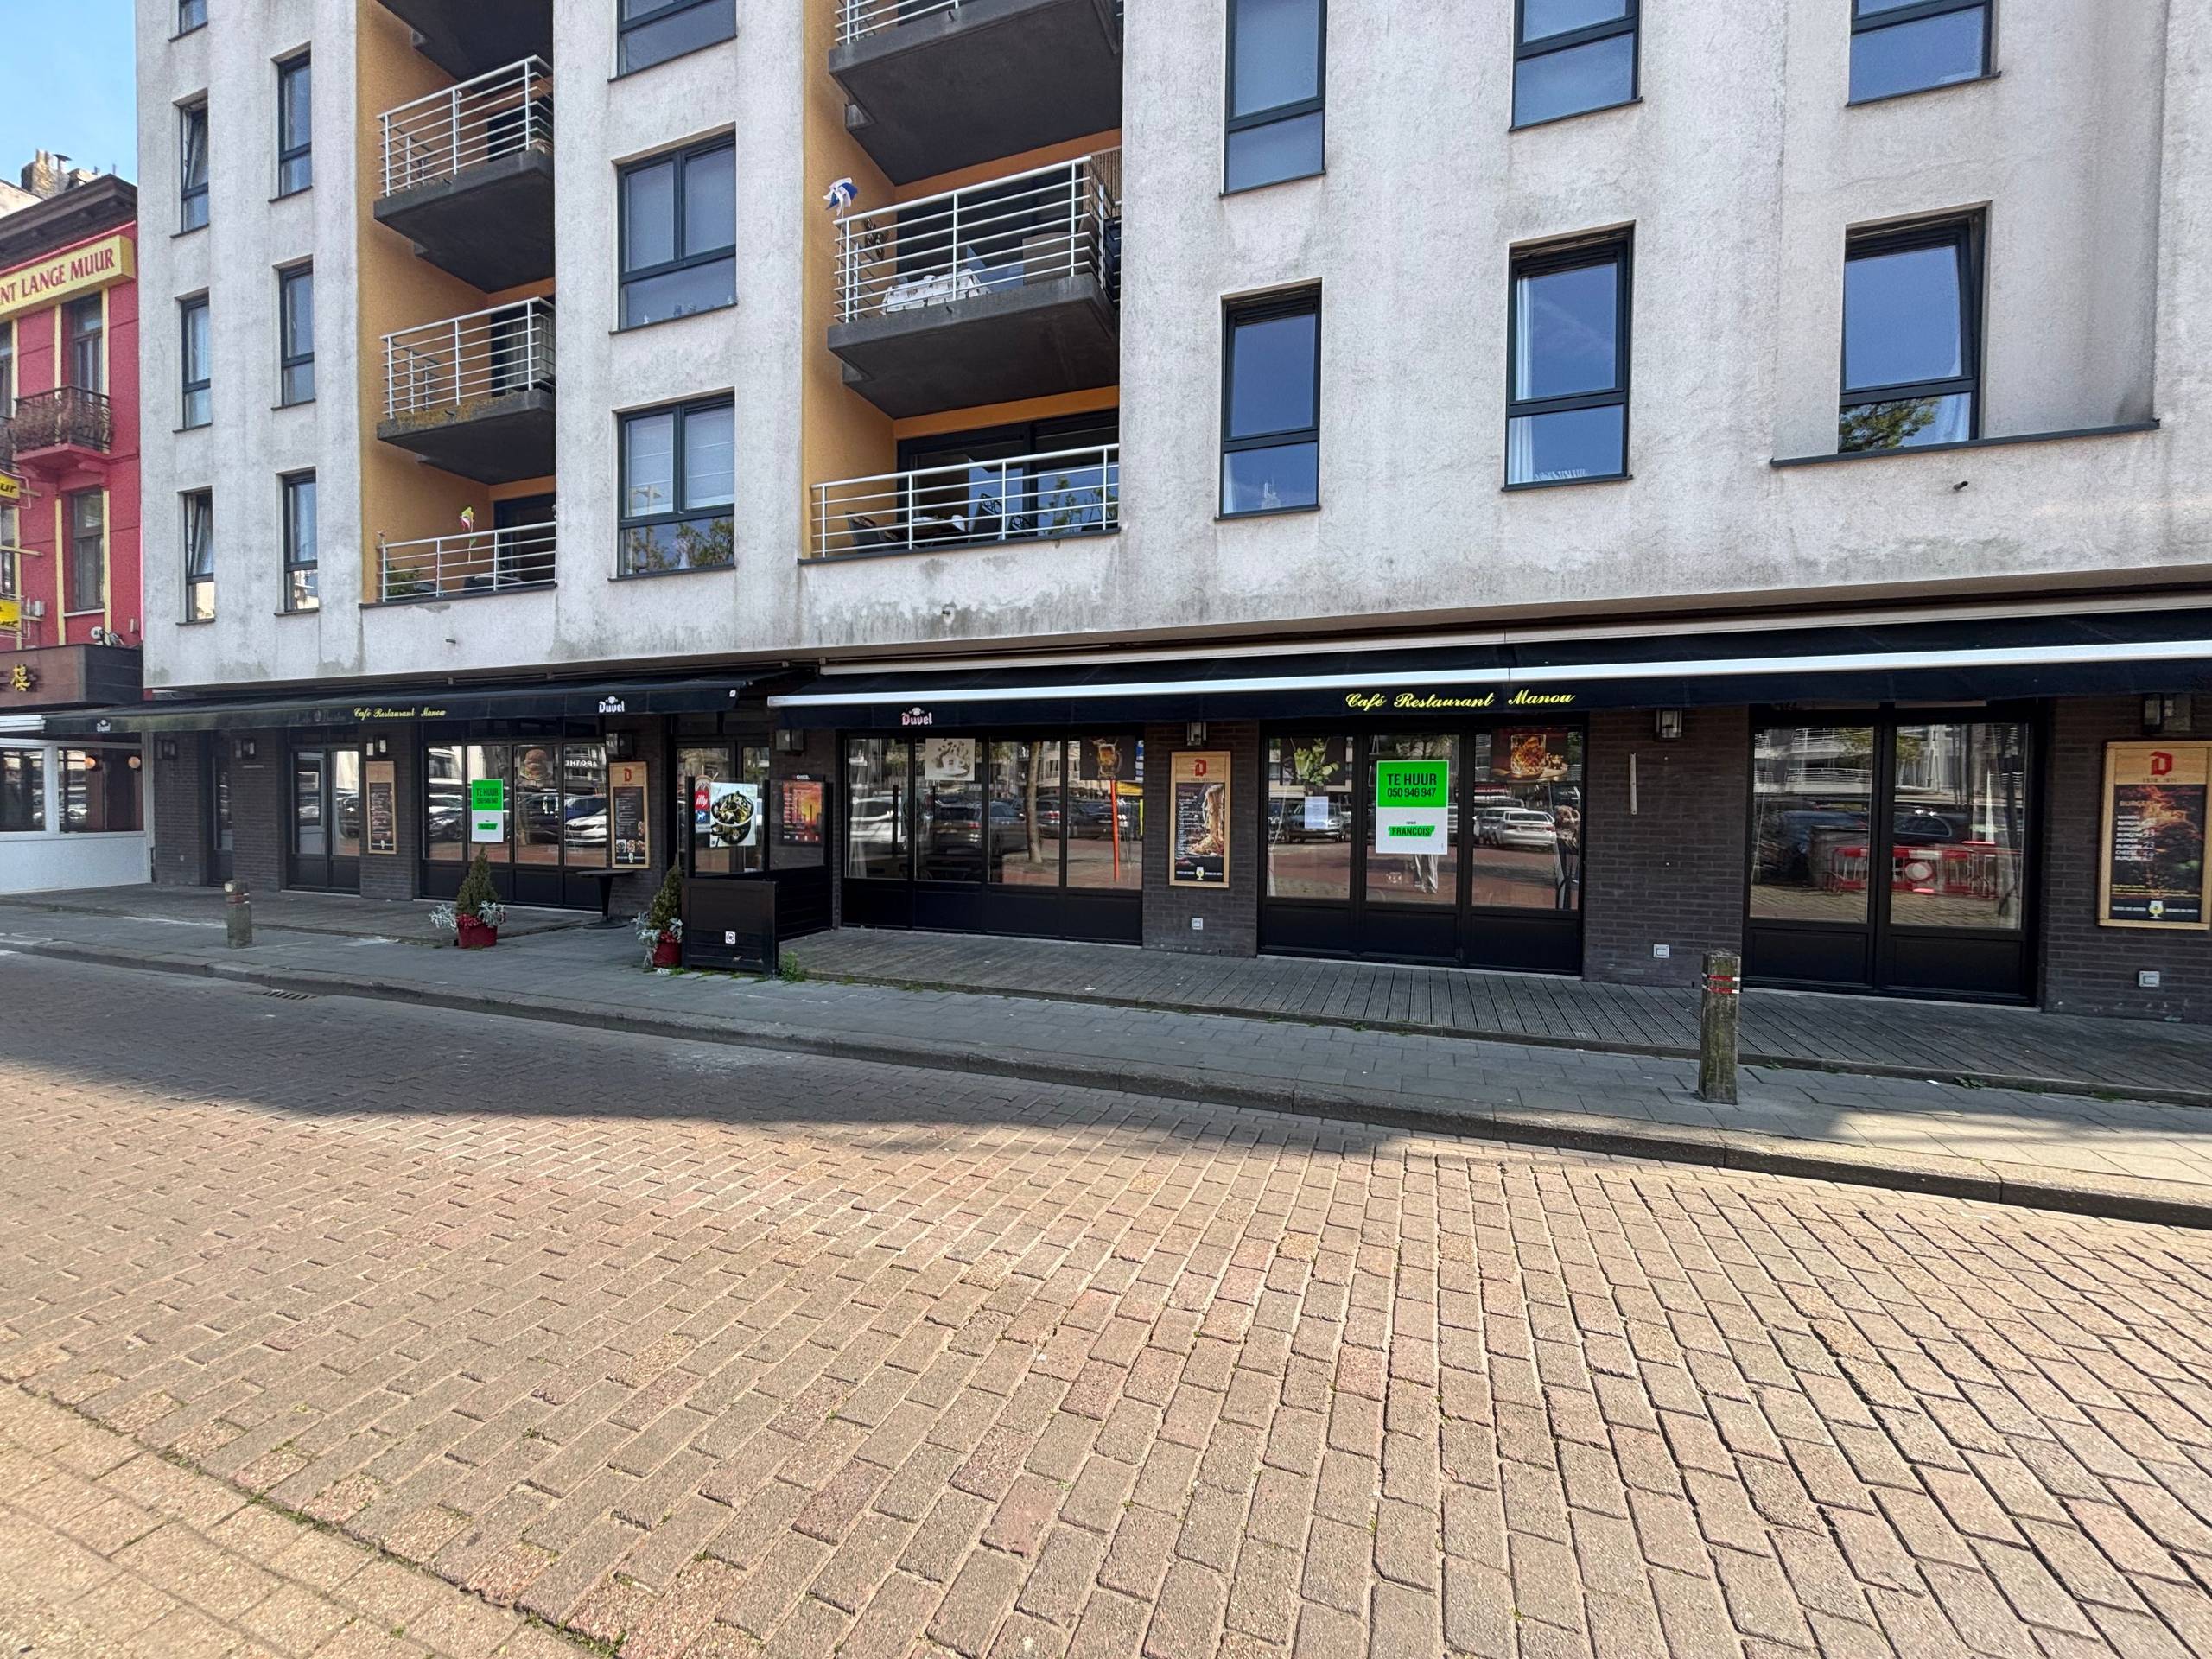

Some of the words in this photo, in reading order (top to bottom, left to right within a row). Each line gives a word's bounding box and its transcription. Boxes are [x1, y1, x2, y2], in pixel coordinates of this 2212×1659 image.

[21, 264, 66, 297] LANGE
[70, 248, 115, 281] MUUR
[1345, 692, 1384, 711] Café
[1393, 691, 1494, 708] Restaurant
[1508, 689, 1576, 706] Manou
[599, 701, 625, 713] Duvel
[901, 712, 932, 725] Duvel
[1387, 774, 1400, 785] TE
[1404, 773, 1437, 785] HUUR
[1387, 788, 1402, 797] 050
[1404, 788, 1420, 797] 946
[1421, 788, 1436, 797] 947
[696, 794, 708, 808] illy
